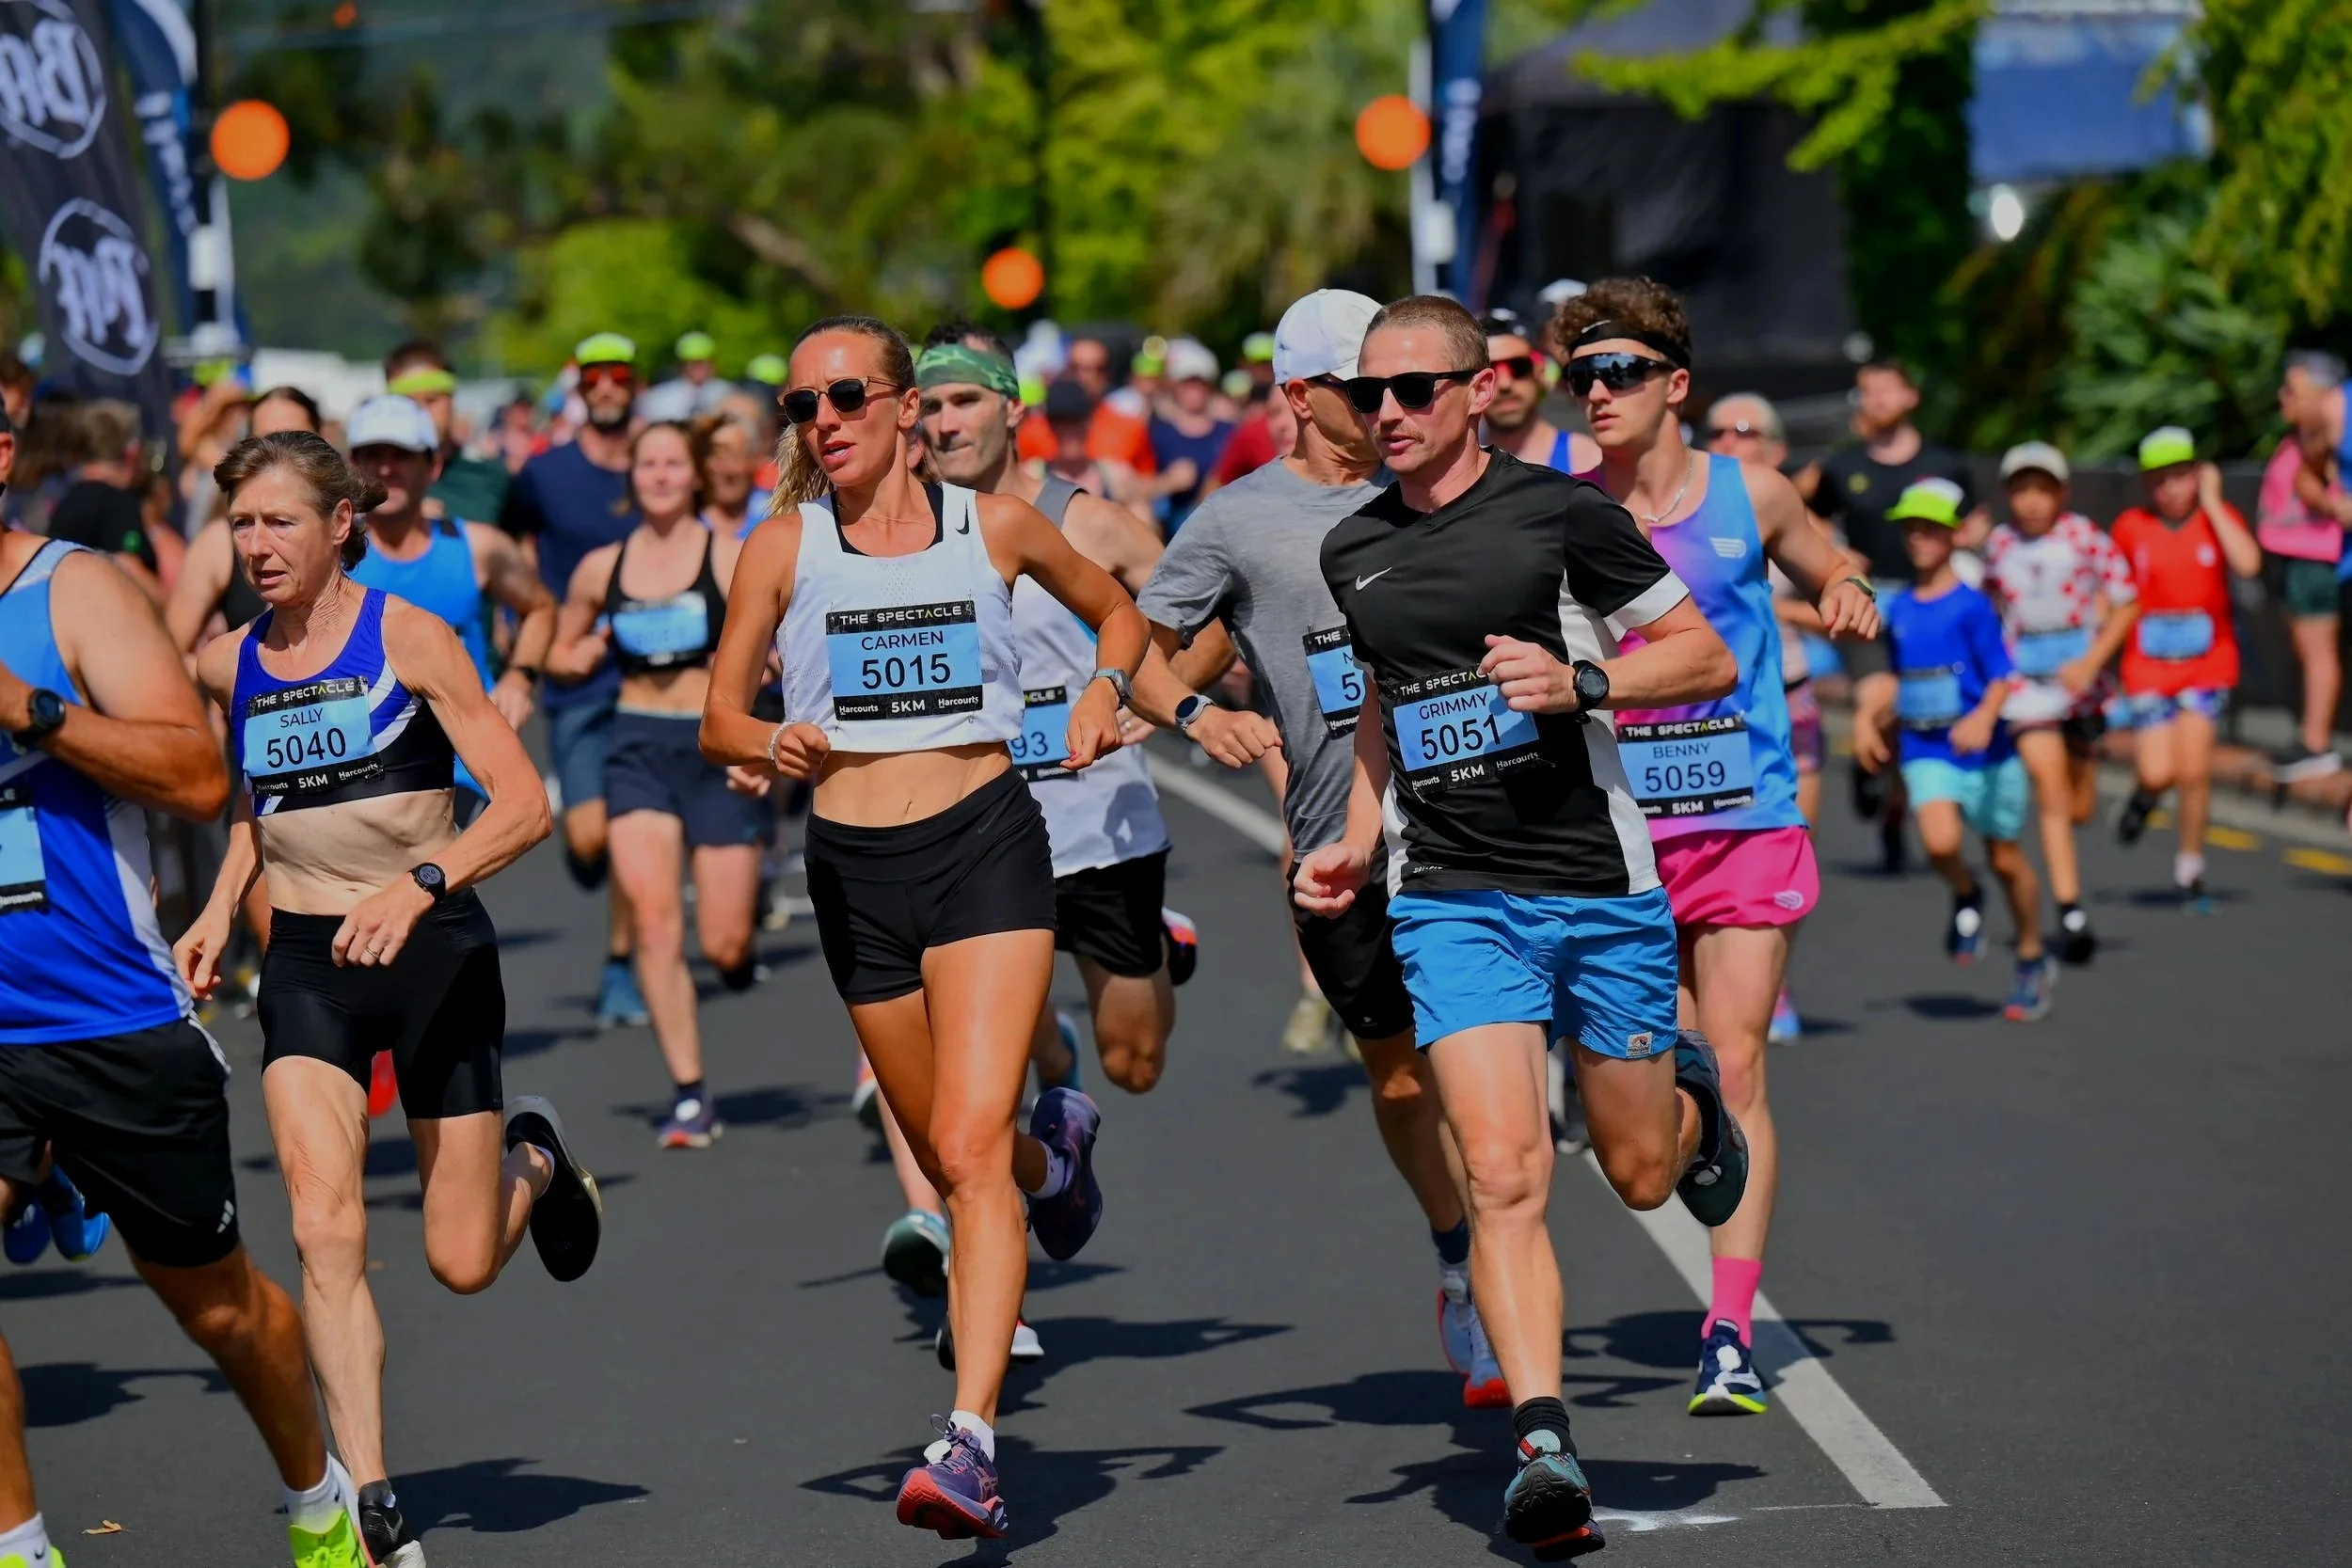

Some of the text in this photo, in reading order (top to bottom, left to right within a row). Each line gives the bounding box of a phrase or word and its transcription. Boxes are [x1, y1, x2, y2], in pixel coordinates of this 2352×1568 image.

[840, 605, 962, 626] THE SPECTACLE
[861, 630, 944, 651] CARMEN
[1314, 630, 1342, 645] THE
[862, 653, 951, 689] 5015
[256, 682, 355, 708] THE SPECTACLE
[1400, 672, 1491, 696] THE SPECTAC
[839, 695, 979, 715] Harcourts 5KM Harcourts
[1419, 691, 1488, 721] GRIMMY
[279, 707, 324, 728] SALLY
[1329, 715, 1360, 729] Harcour
[1626, 717, 1735, 737] THE SPECTACLE
[267, 727, 346, 768] 5040
[1010, 731, 1048, 758] 93
[1421, 713, 1502, 761] 5051
[1653, 741, 1710, 759] BENNY
[298, 773, 328, 789] 5KM
[339, 763, 378, 780] Harcourts
[1411, 752, 1539, 790] Harcourts 5KM Harcourts
[1645, 760, 1725, 794] 5059
[1672, 800, 1705, 816] 5KM
